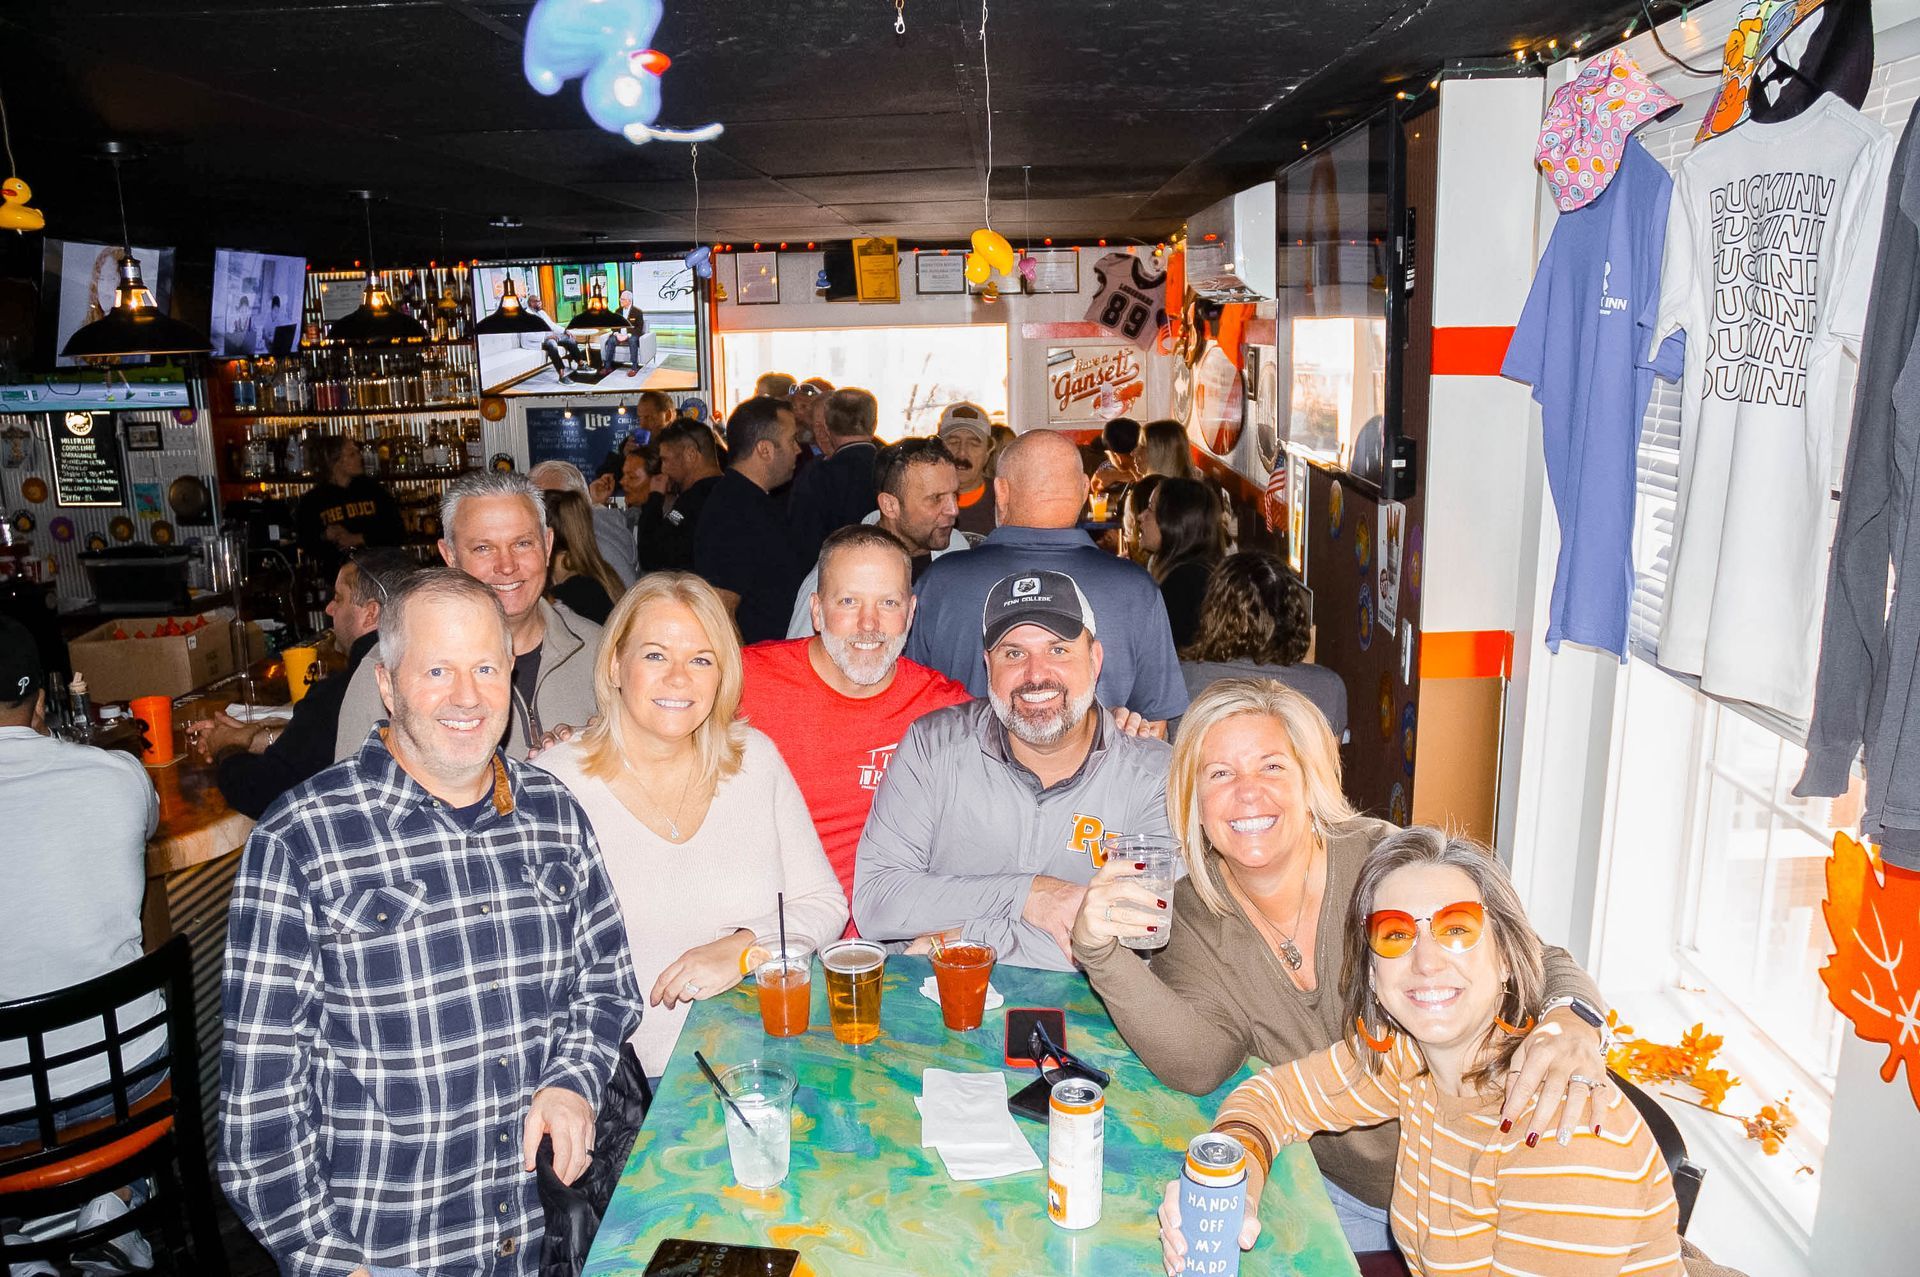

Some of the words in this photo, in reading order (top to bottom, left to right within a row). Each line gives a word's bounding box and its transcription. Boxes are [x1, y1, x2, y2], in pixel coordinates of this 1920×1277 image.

[1710, 172, 1836, 224] DUCKINN
[1604, 297, 1628, 310] INN
[1100, 291, 1151, 340] 89
[584, 413, 612, 431] Lite
[1003, 598, 1020, 608] PENN
[17, 676, 31, 696] P
[1188, 1192, 1239, 1212] HANDS
[1199, 1219, 1225, 1233] OFF
[1195, 1240, 1222, 1254] MY
[1186, 1257, 1227, 1275] HARD
